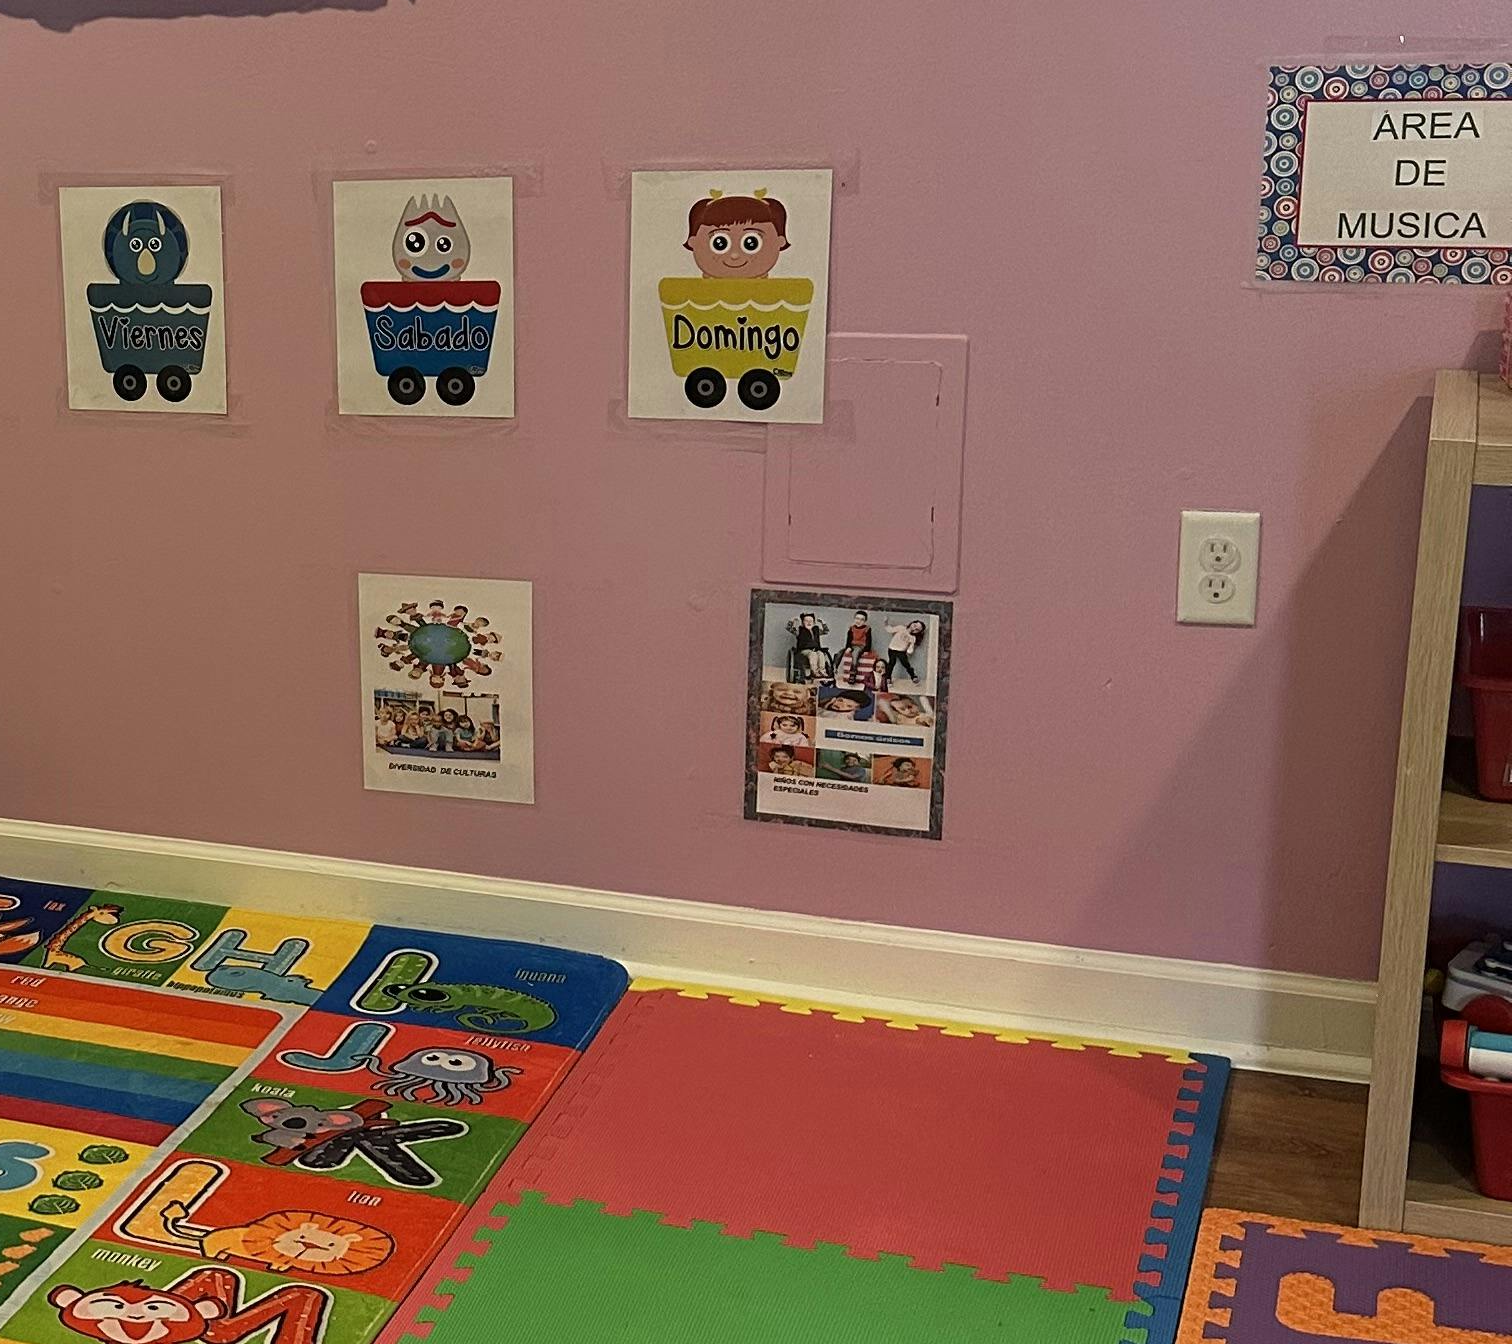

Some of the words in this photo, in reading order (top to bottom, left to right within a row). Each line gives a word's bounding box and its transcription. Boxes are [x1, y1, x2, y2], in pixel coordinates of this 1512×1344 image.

[1395, 159, 1447, 186] DE
[1338, 212, 1487, 239] MUSICA
[97, 316, 204, 351] Viernes
[374, 315, 489, 353] Sabado
[672, 314, 800, 359] Domingo
[389, 762, 436, 774] DIVERSIDAD
[440, 767, 452, 775] DE
[453, 768, 497, 778] CULTURAS
[798, 779, 815, 787] CON
[773, 786, 819, 796] ESPECIALES
[44, 900, 66, 912] fox
[98, 919, 200, 965] G
[189, 928, 312, 974] H
[9, 975, 47, 988] red
[111, 965, 162, 981] giraffe
[276, 1020, 395, 1072] J
[251, 1081, 296, 1099] koala
[296, 1106, 469, 1189] K
[113, 1158, 231, 1253] L
[346, 1190, 383, 1207] lion
[90, 1246, 162, 1273] monkey
